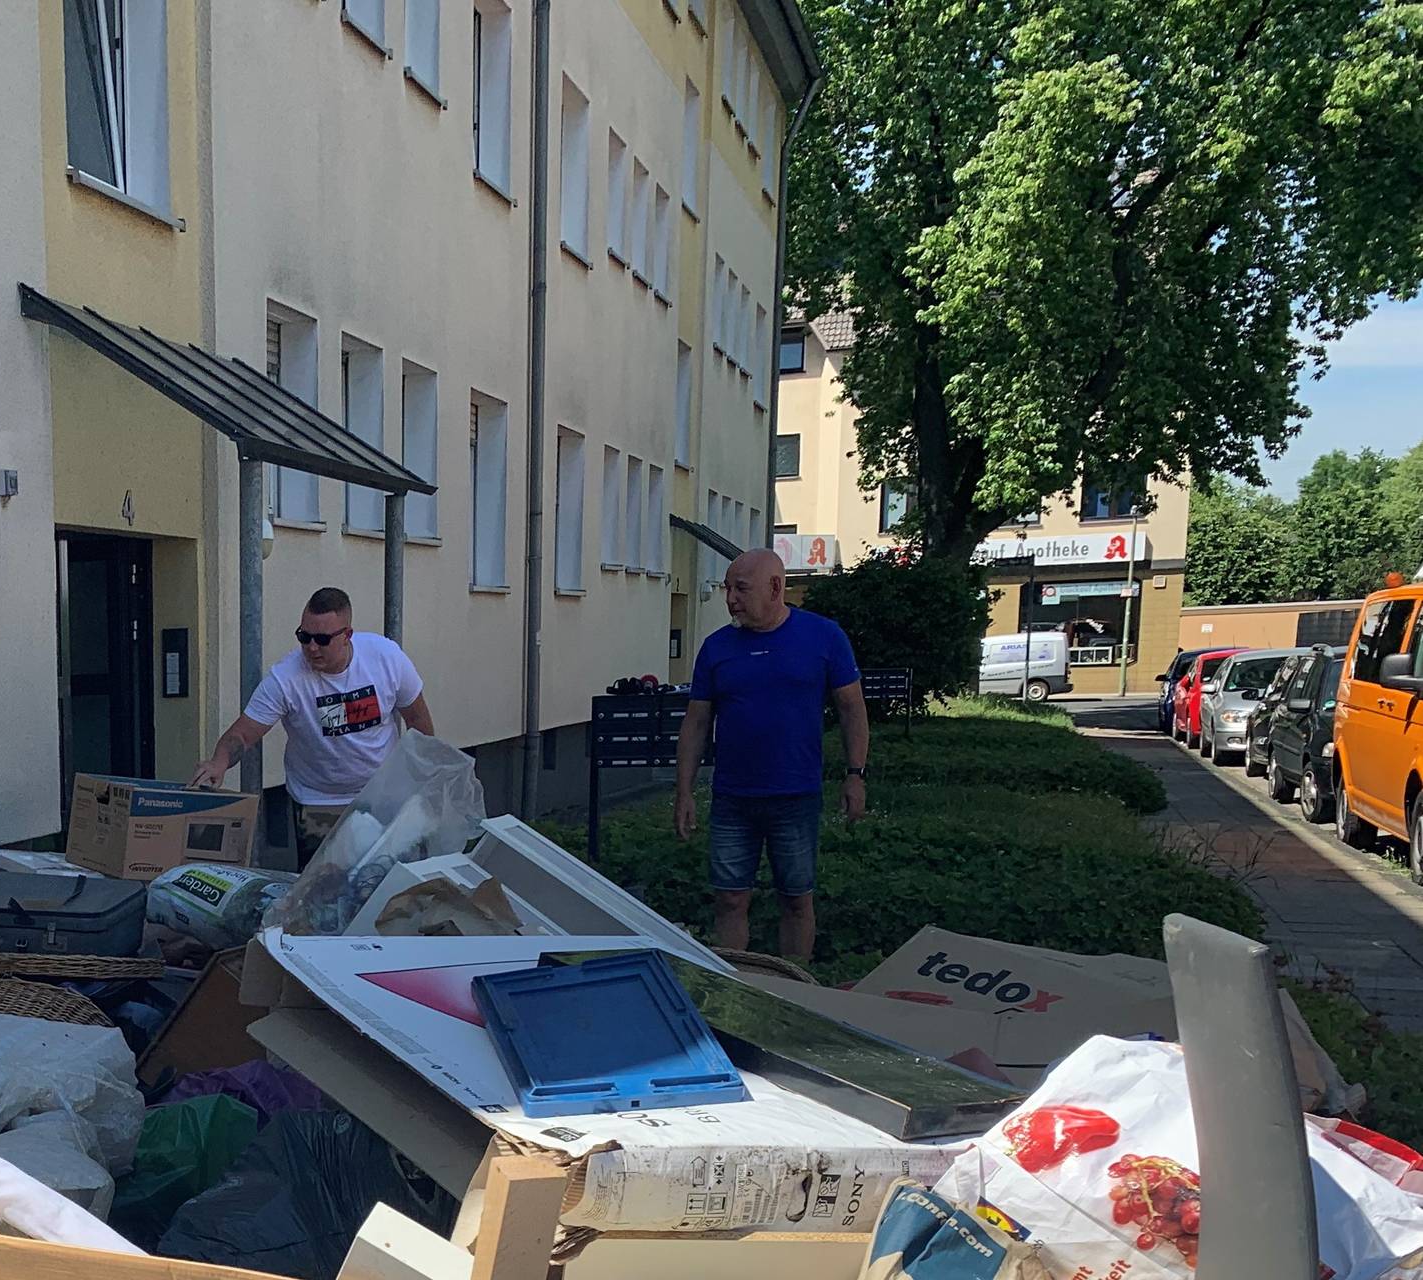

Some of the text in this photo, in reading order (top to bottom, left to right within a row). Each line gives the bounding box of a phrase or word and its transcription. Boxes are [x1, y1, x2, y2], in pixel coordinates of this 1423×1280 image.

[121, 488, 135, 526] 4
[1016, 540, 1089, 559] Apotheke
[319, 687, 371, 704] OMMY
[137, 796, 184, 809] Panasonic
[917, 951, 1065, 1013] tedox
[842, 1164, 866, 1227] SONY
